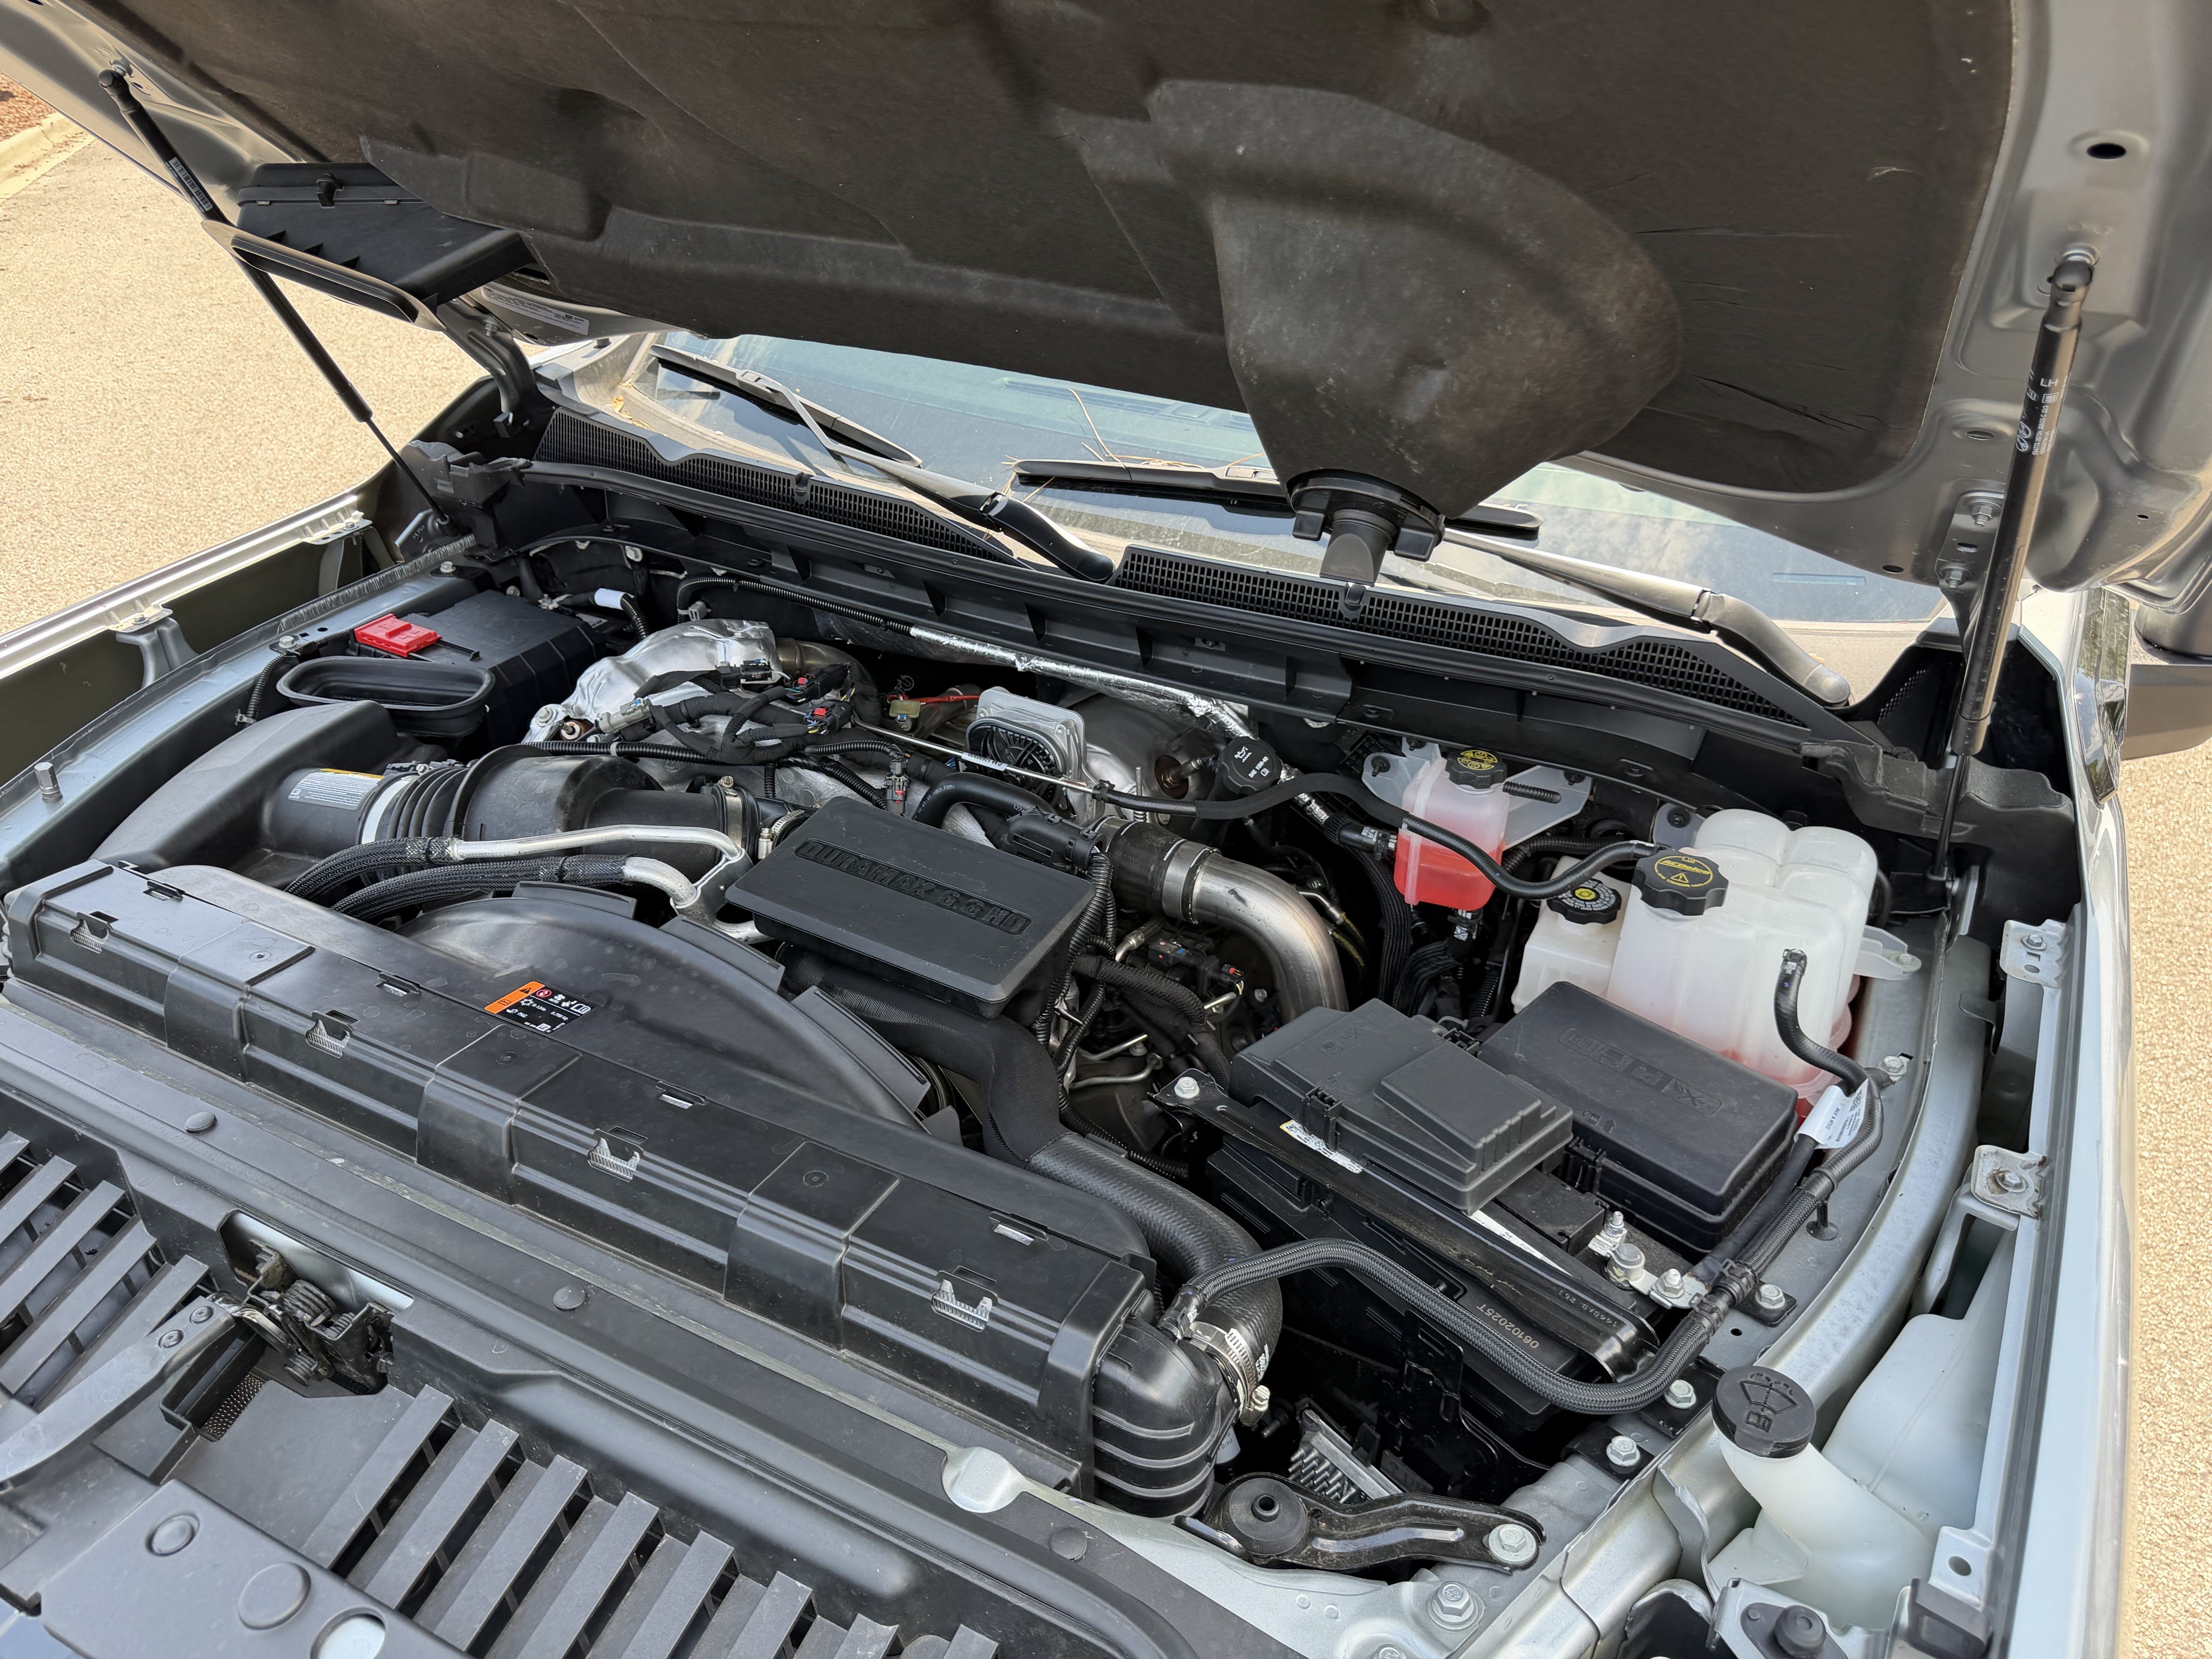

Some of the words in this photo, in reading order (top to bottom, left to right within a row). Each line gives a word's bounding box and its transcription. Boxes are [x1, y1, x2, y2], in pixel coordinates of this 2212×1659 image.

[1248, 768, 1257, 778] SAE
[1255, 756, 1269, 770] 15W-40
[799, 841, 936, 898] DURAMAX
[937, 889, 985, 916] 6.6
[982, 904, 1029, 932] HD
[1476, 1301, 1539, 1350] 06102025T
